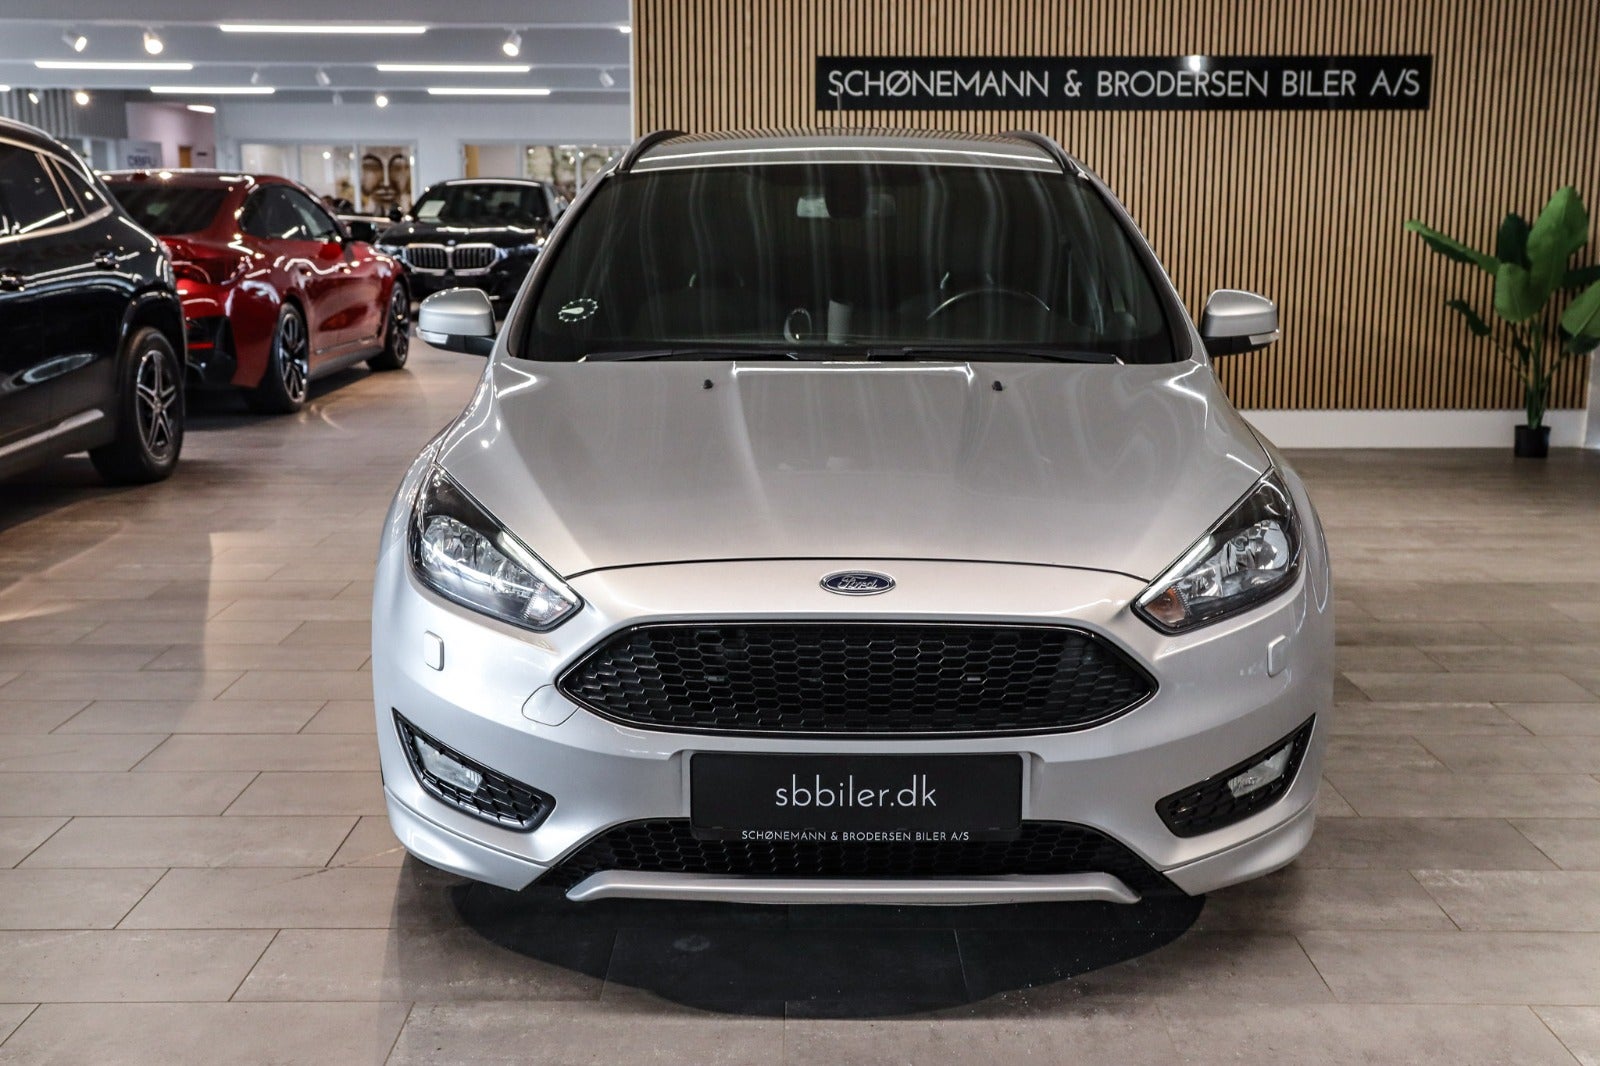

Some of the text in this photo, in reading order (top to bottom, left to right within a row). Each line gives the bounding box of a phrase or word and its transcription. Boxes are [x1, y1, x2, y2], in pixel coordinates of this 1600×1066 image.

[827, 69, 1420, 97] SCHØNEMANN & BRODERSEN BILER A/S
[837, 576, 880, 590] Ford
[774, 773, 937, 808] sbbiler.dk
[741, 830, 970, 842] SCHØNEMANN & BRODERSEN BILER A/S
